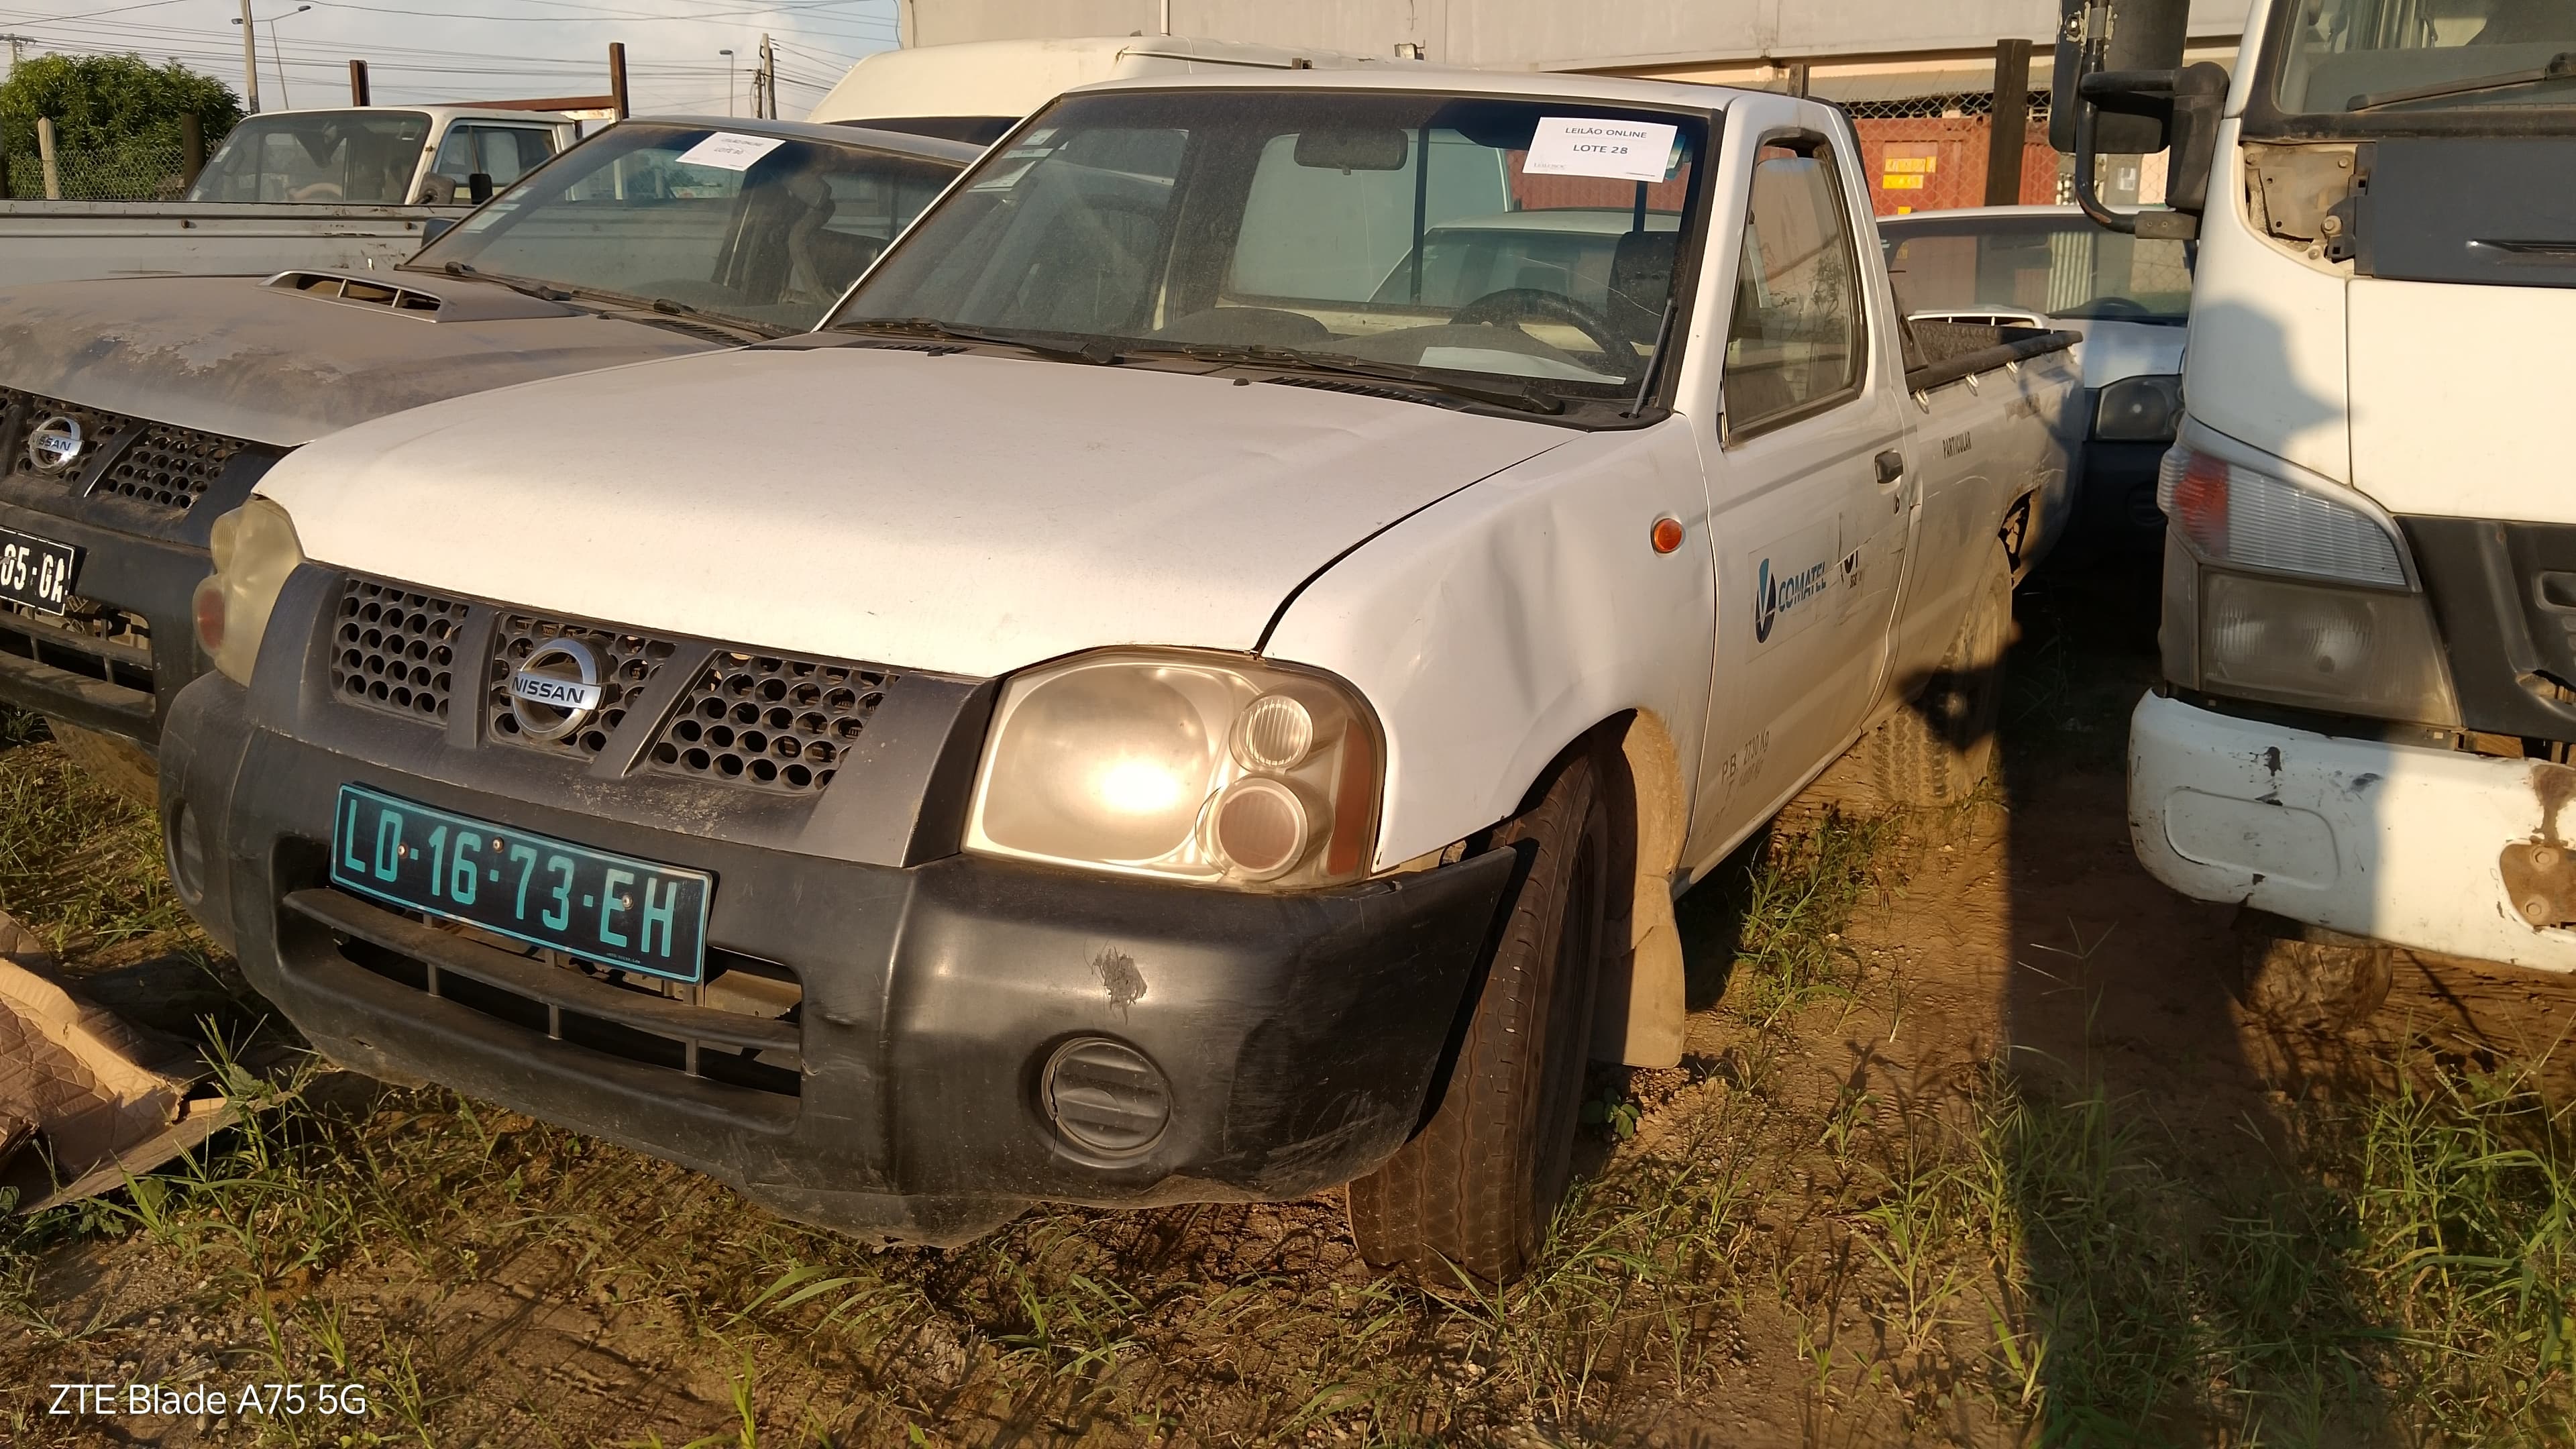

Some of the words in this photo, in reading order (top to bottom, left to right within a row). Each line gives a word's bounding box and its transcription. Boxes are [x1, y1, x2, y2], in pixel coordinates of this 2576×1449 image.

[1565, 127, 1603, 135] LEILÃO
[1606, 129, 1648, 138] ONLINE
[1573, 144, 1607, 153] LOTE
[1611, 146, 1628, 154] 28
[31, 434, 71, 451] SSAN
[1778, 561, 1826, 612] COMATEL
[511, 676, 585, 704] NISSAN
